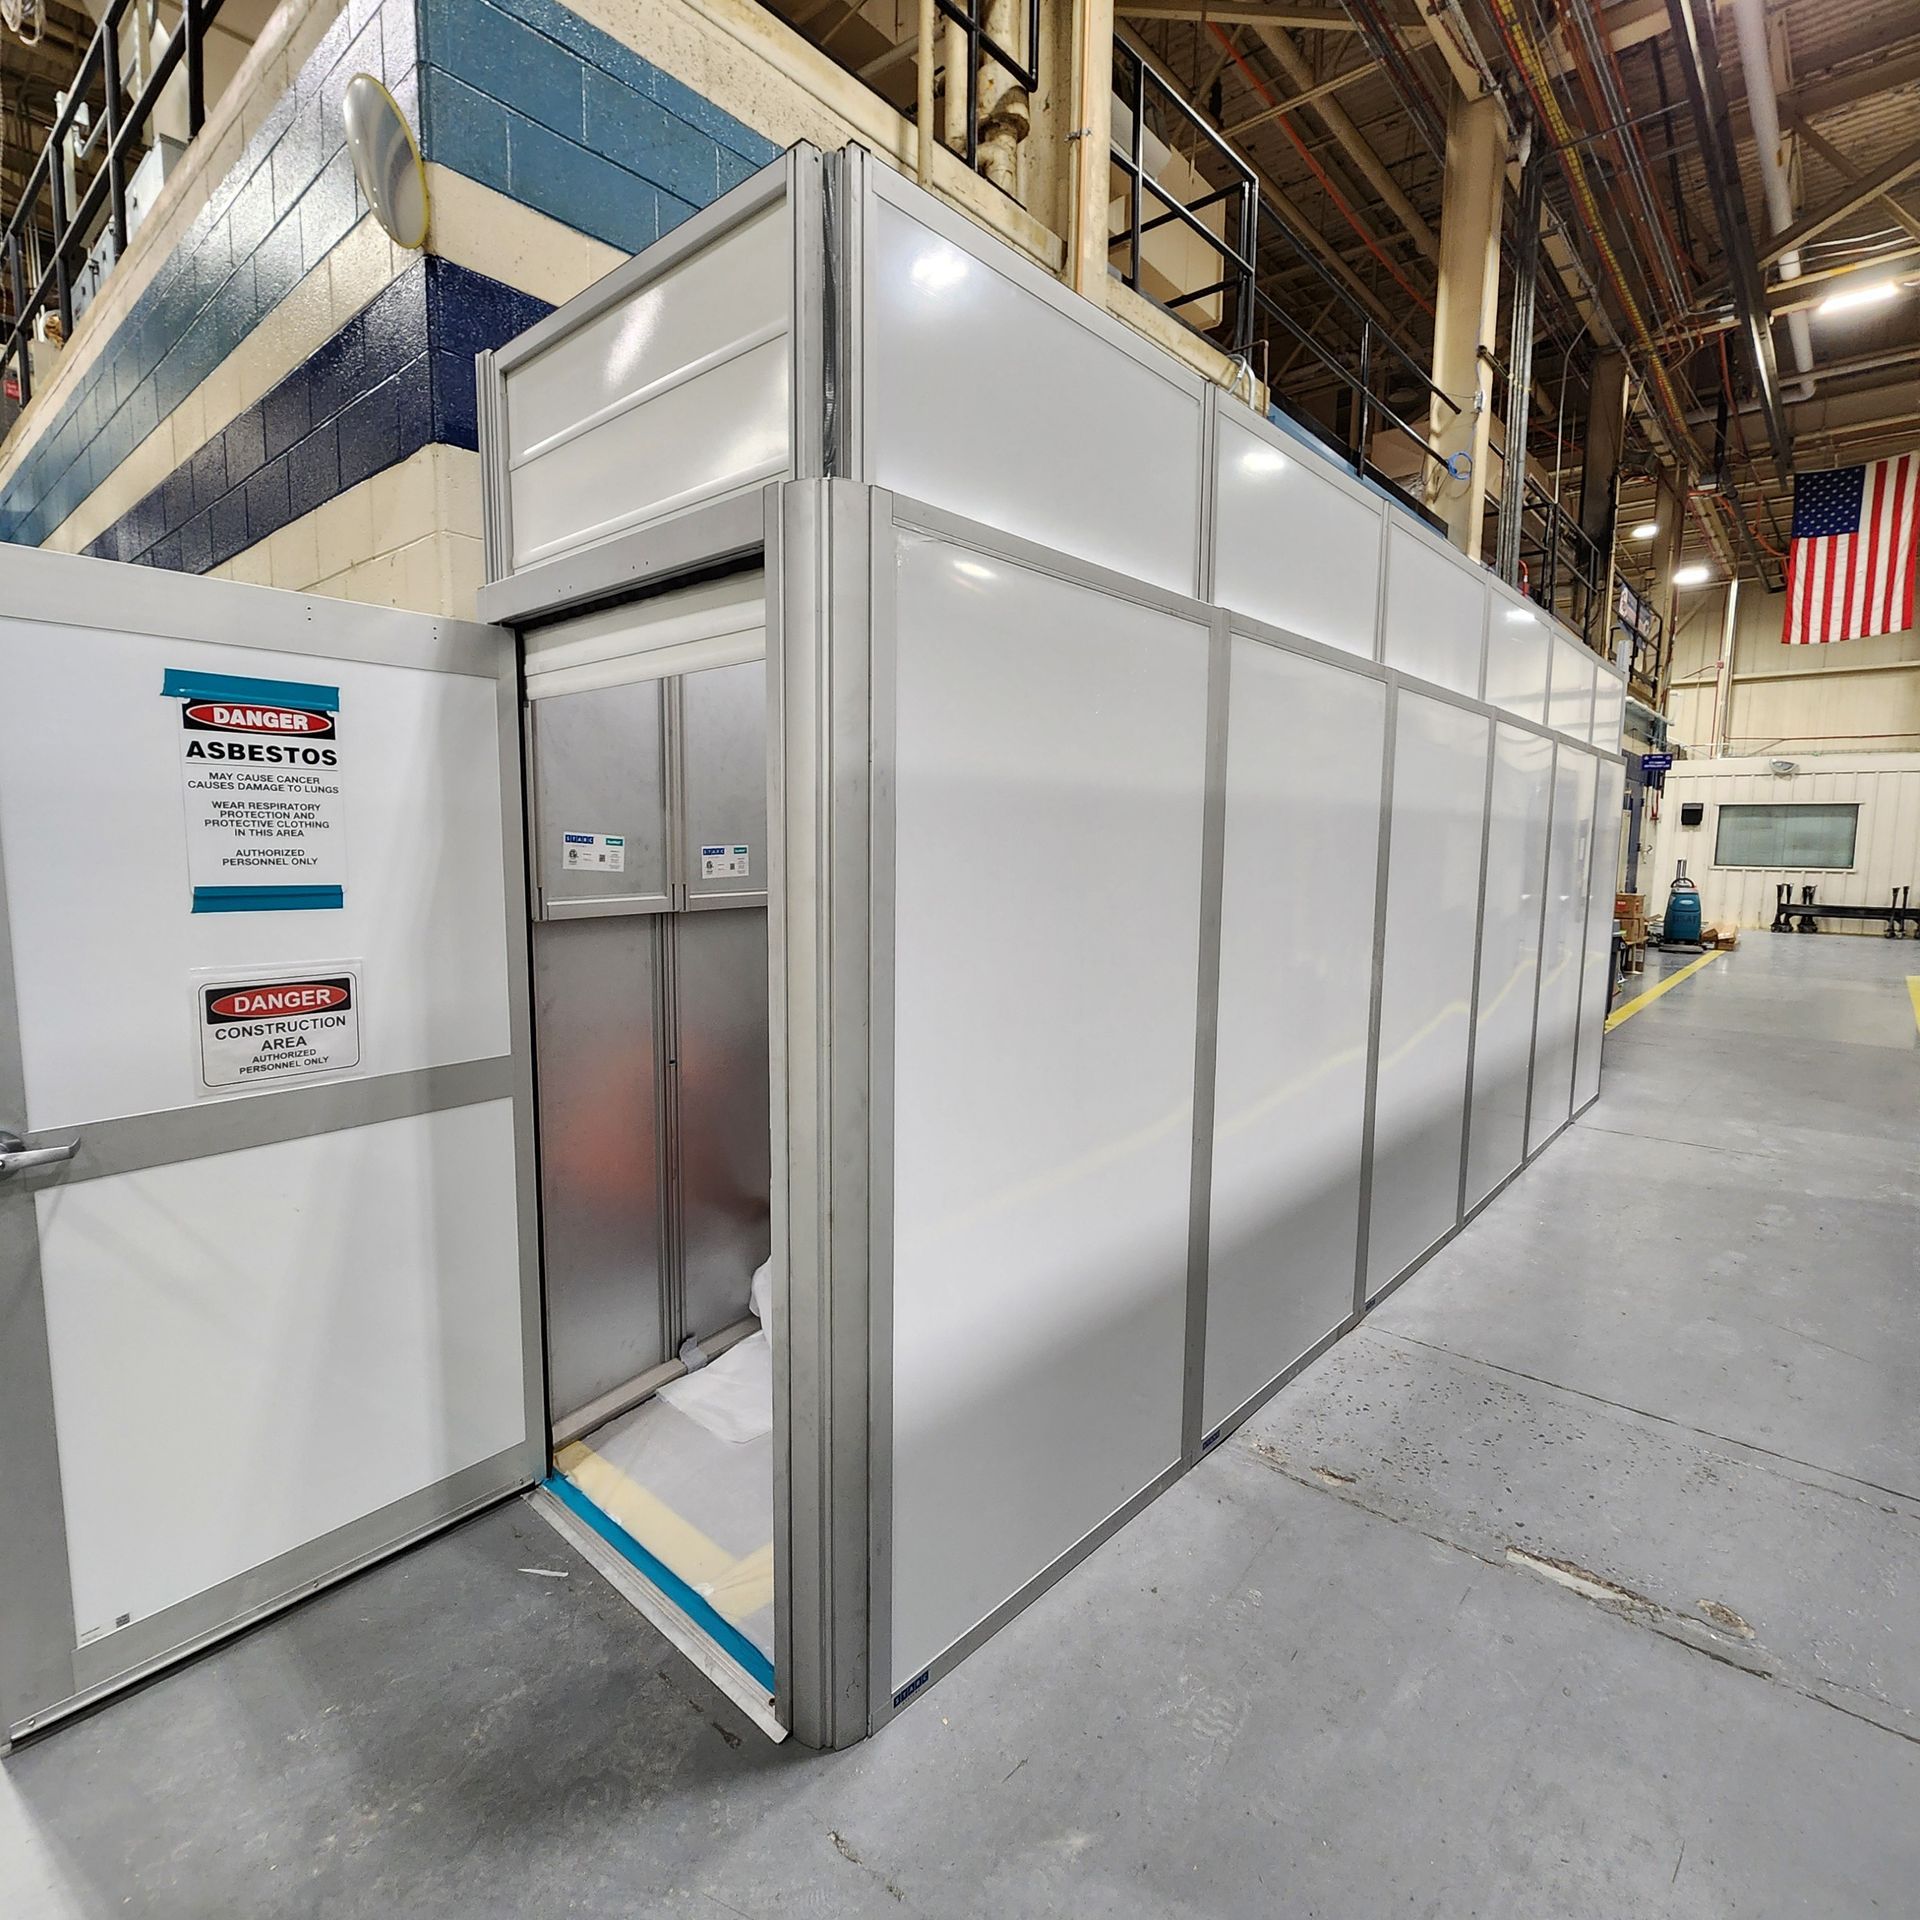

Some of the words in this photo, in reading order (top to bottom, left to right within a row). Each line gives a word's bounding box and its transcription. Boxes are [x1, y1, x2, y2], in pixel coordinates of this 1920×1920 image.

[213, 707, 308, 731] DANGER
[186, 740, 337, 766] ASBESTOS
[209, 772, 233, 781] MAY
[236, 773, 273, 782] CAUSE
[277, 775, 320, 784] CANCER
[188, 781, 234, 790] CAUSES
[238, 783, 285, 792] DAMAGE
[288, 785, 301, 793] TO
[304, 785, 339, 794] LUNGS
[212, 801, 245, 810] WEAR
[248, 802, 321, 811] RESPIRATORY
[220, 811, 290, 819] PROTECTION
[293, 812, 315, 820] AND
[204, 819, 273, 828] PROTECTIVE
[277, 820, 329, 829] CLOTHING
[235, 828, 246, 837] IN
[248, 829, 273, 837] THIS
[276, 829, 304, 837] AREA
[236, 849, 305, 857] AUTHORIZED
[222, 858, 288, 866] PERSONNEL
[291, 858, 318, 866] ONLY
[234, 989, 331, 1013] DANGER
[215, 1015, 346, 1040] CONSTRUCTION
[261, 1036, 307, 1051] AREA
[252, 1049, 316, 1063] AUTHORIZED
[239, 1061, 300, 1074] PERSONNEL
[304, 1056, 329, 1066] ONLY
